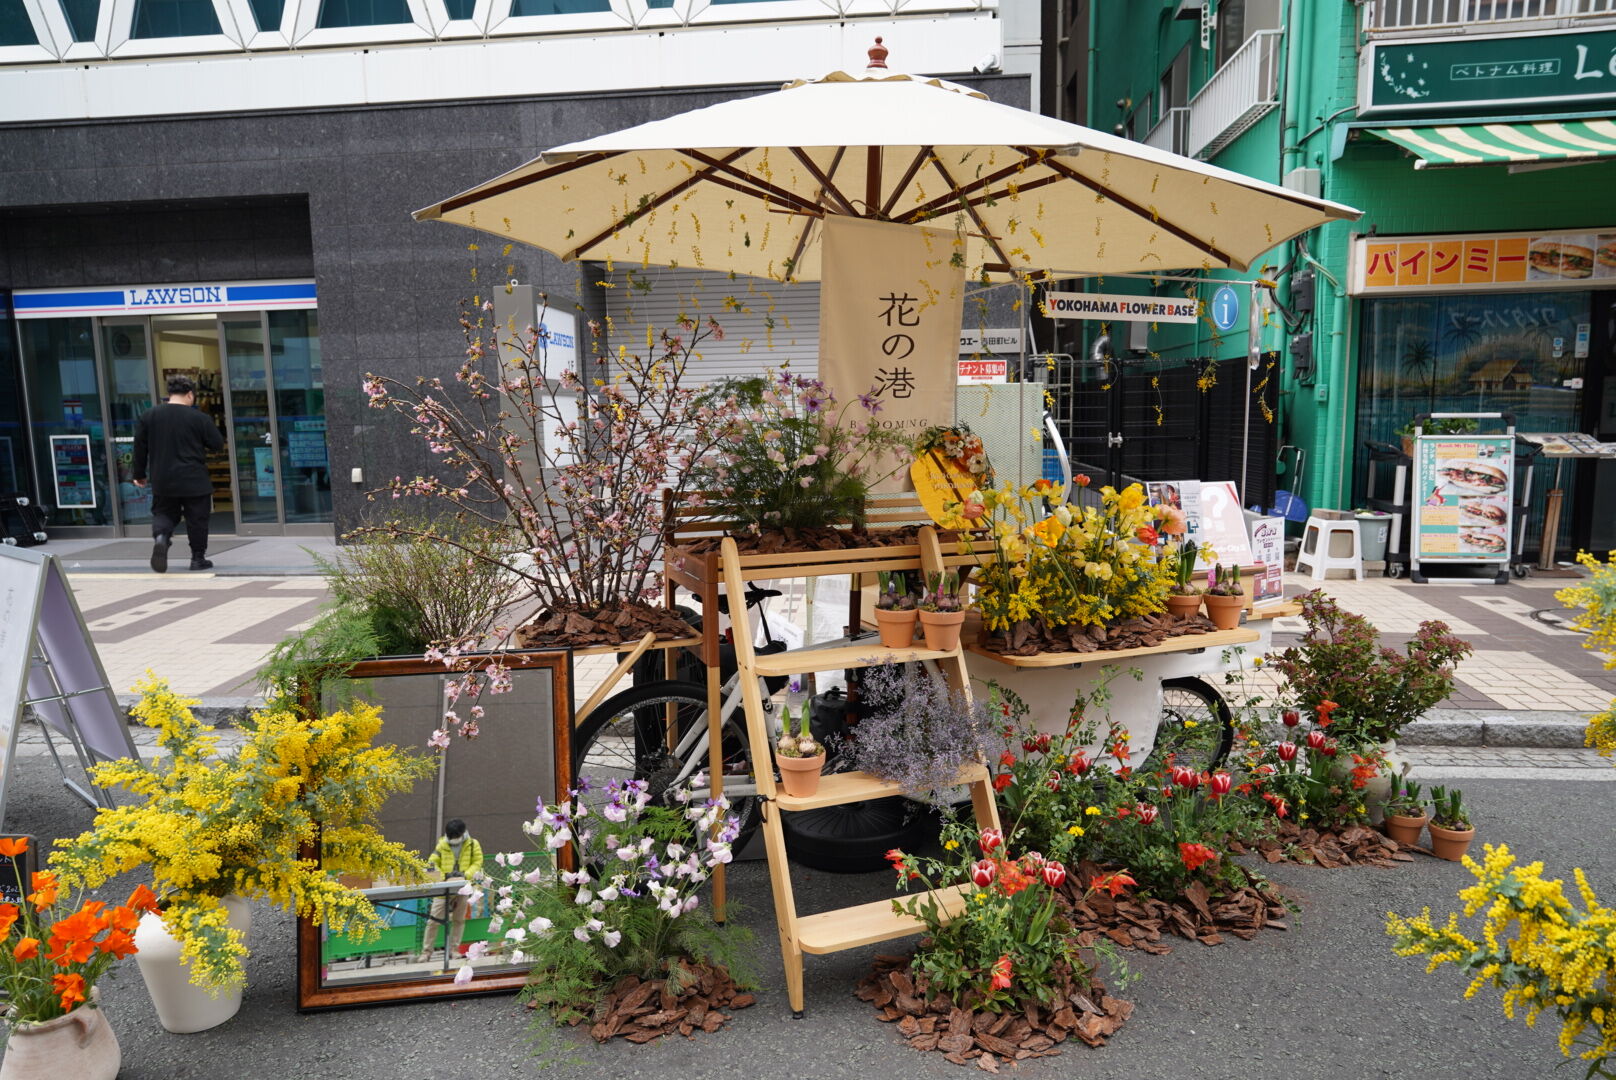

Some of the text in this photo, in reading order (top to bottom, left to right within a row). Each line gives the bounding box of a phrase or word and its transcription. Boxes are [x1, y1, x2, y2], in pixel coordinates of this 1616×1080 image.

[1456, 62, 1553, 77] ベトナム料理
[1368, 247, 1525, 276] バインミー
[129, 286, 222, 305] LAWSON
[1050, 298, 1194, 317] YOKOHAMA FLOWER BASE
[874, 292, 920, 398] 花の港
[959, 363, 1004, 375] テナント募集中
